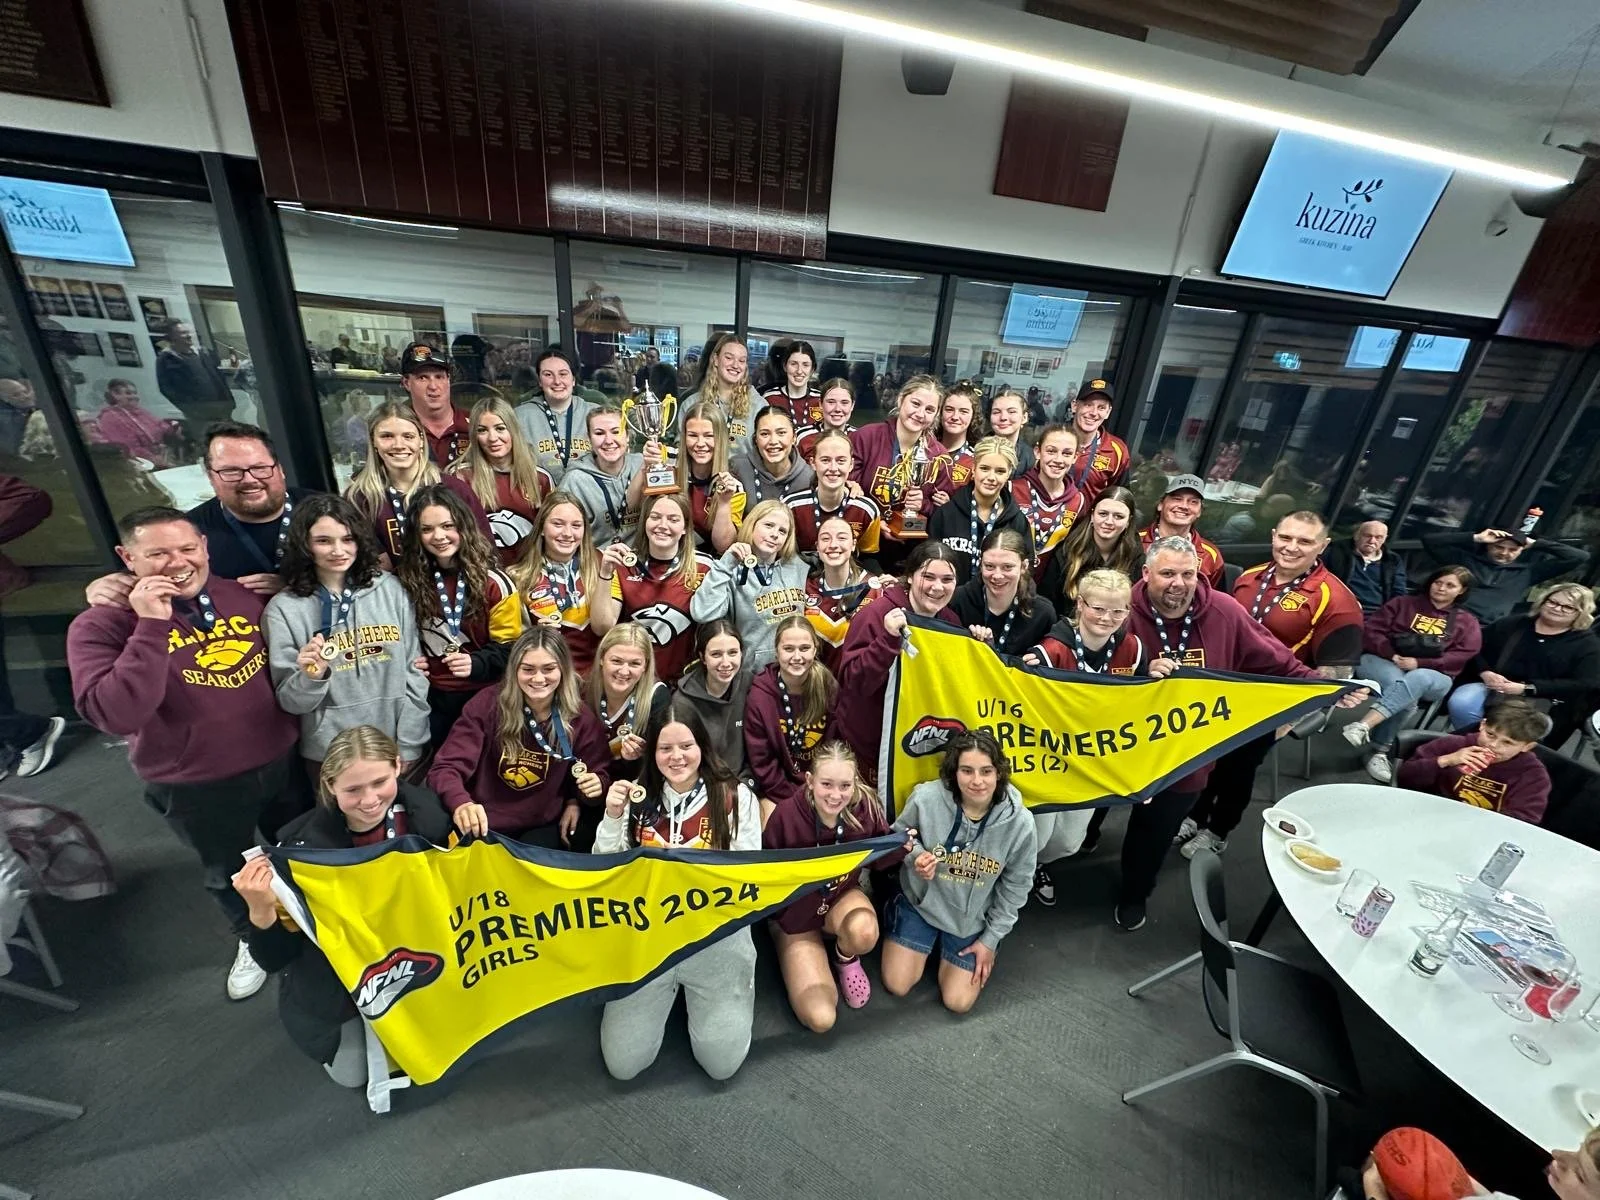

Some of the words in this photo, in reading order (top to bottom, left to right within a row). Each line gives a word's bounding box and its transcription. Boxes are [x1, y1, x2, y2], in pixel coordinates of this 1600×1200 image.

[1295, 192, 1377, 239] kuzina
[538, 438, 592, 453] SEAERS
[1178, 478, 1199, 487] NYC
[327, 625, 401, 651] ARHERS
[182, 647, 269, 689] SEARCHERS
[977, 698, 1023, 718] U/16
[1145, 696, 1232, 742] 2024
[909, 725, 950, 746] NFNL
[1042, 754, 1069, 774] (2)
[941, 851, 1001, 875] ARHERS
[449, 890, 510, 932] U/18
[454, 896, 650, 968] PREMIERS
[660, 882, 760, 924] 2024
[462, 943, 539, 989] GIRLS
[356, 960, 415, 1007] NFNL
